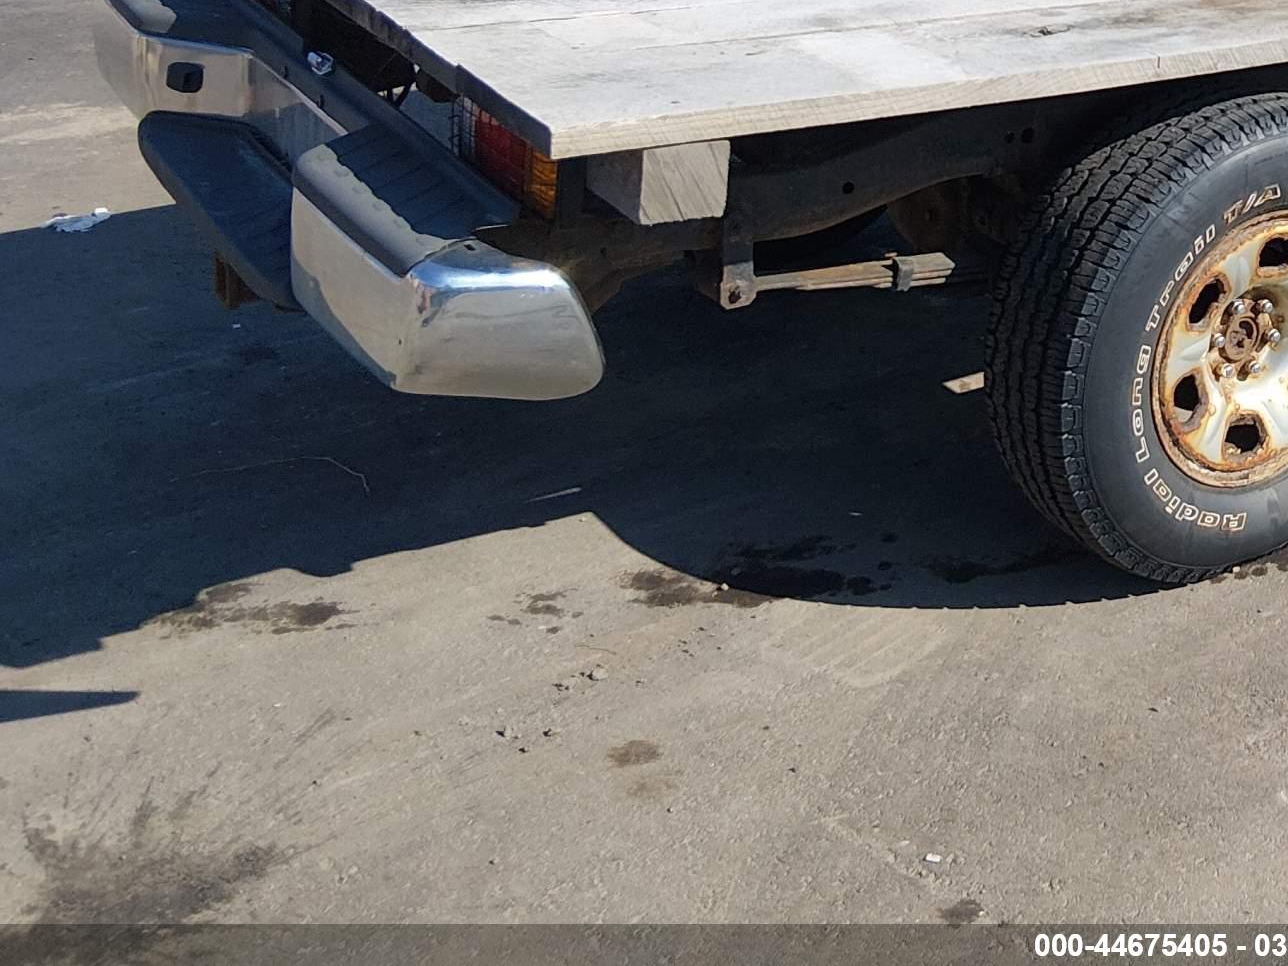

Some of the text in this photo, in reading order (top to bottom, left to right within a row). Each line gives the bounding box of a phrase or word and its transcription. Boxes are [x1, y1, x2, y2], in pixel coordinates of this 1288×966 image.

[1131, 183, 1282, 532] Radial Long Trail T/A
